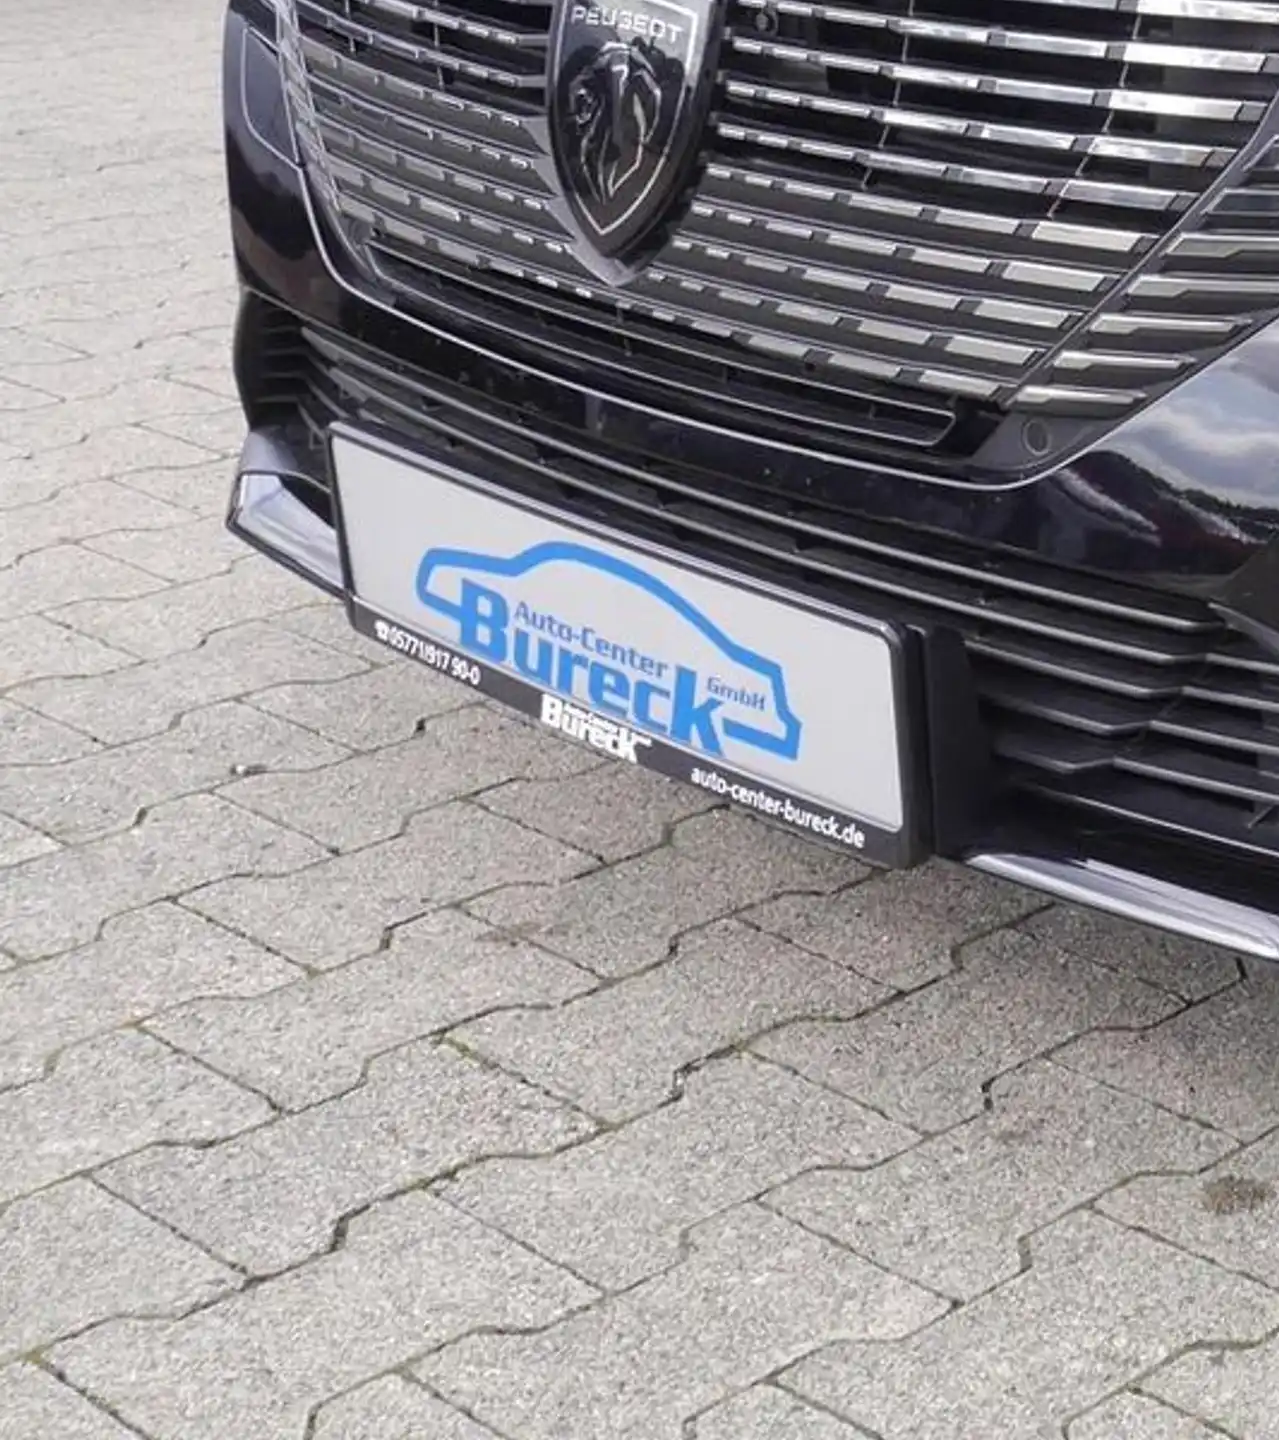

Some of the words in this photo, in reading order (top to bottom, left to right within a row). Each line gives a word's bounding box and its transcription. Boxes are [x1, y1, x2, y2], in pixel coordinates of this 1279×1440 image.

[571, 4, 684, 44] PEUGEOT
[460, 578, 725, 759] Bureck
[514, 601, 669, 679] Auto-Center
[541, 693, 638, 764] Bureck
[706, 675, 766, 711] GmbH
[690, 767, 866, 849] auto-center-bureck.de
